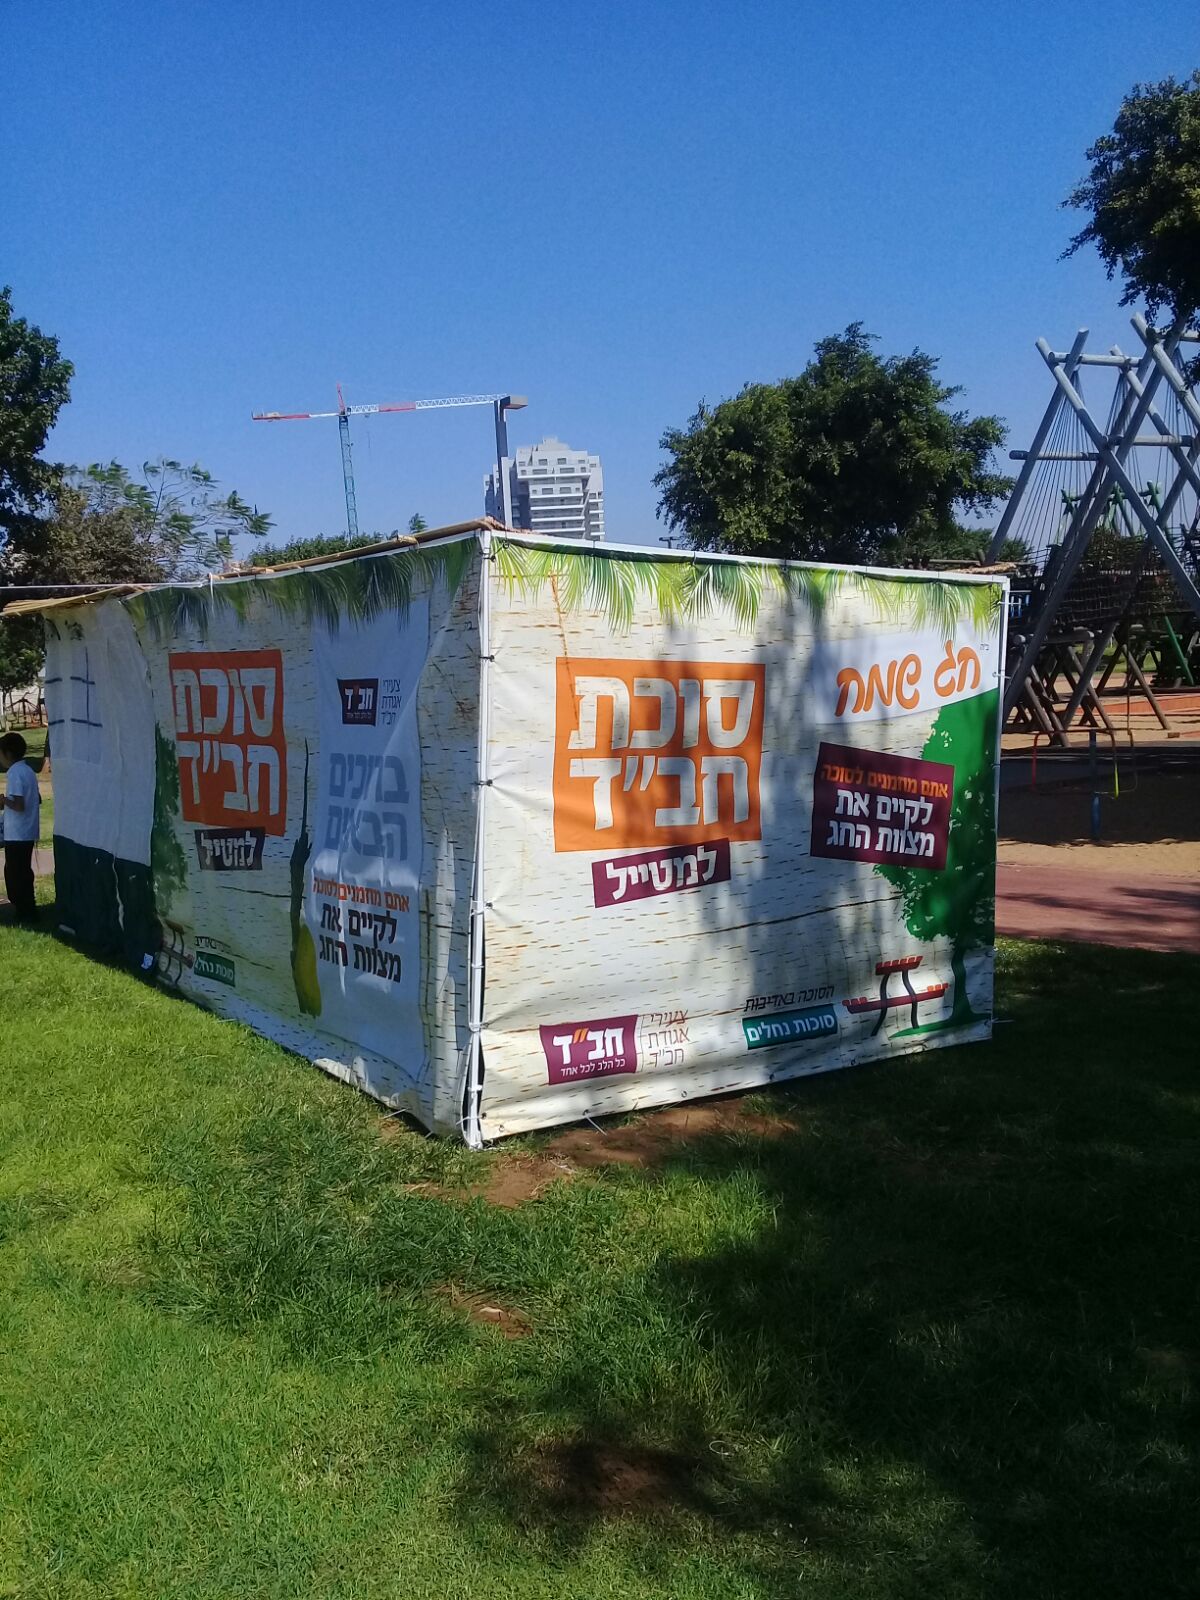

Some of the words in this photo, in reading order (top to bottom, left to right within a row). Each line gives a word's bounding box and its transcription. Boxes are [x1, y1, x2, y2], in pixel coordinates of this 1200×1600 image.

[934, 639, 981, 697] חג
[835, 653, 922, 717] שמח
[172, 667, 276, 737] סוכת
[568, 676, 756, 750] סוכת
[176, 740, 280, 816] חב"ד
[821, 763, 864, 785] לסוכה
[867, 771, 918, 794] מוזמנים
[569, 755, 749, 831] חב"ד
[920, 779, 949, 799] אתם
[834, 789, 871, 818] את
[876, 796, 934, 830] לקיים
[826, 820, 872, 850] החג
[875, 826, 935, 857] מצוות
[605, 846, 718, 900] למטייל
[338, 882, 382, 907] מוזמנים
[383, 891, 410, 912] אתם
[321, 902, 343, 933] את
[348, 910, 398, 949] לקיים
[319, 934, 349, 967] החג
[353, 943, 402, 984] מצוות
[744, 992, 795, 1012] באדיבות
[797, 985, 835, 1003] הסוכה
[650, 1009, 689, 1028] צעירי
[746, 1021, 792, 1042] נחלים
[792, 1014, 835, 1034] סוכות
[552, 1027, 625, 1065] חב"ד
[648, 1027, 691, 1049] אגודת
[560, 1066, 579, 1077] אחד
[579, 1062, 596, 1074] לכל
[597, 1060, 614, 1071] הלב
[614, 1057, 626, 1068] כל
[649, 1048, 685, 1068] חב"ד
